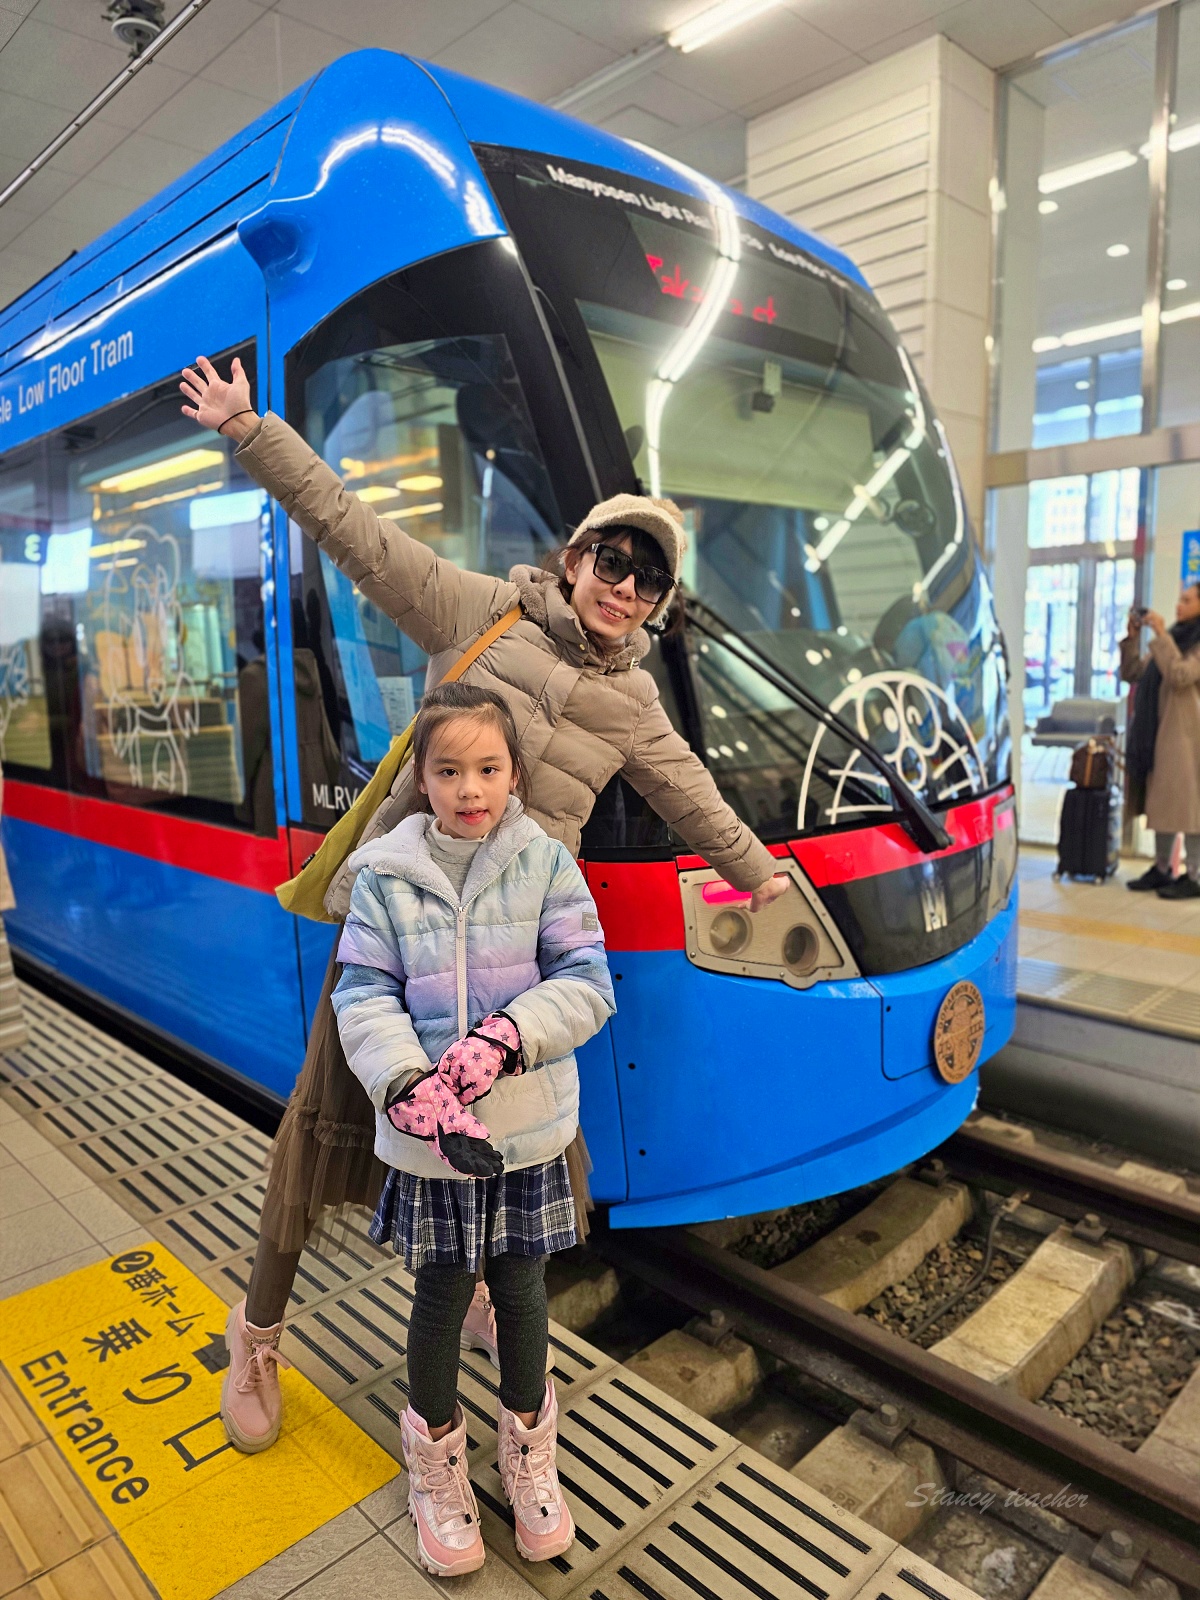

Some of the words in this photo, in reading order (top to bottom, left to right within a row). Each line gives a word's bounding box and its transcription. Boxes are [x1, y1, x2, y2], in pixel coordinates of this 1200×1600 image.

[640, 193, 684, 220] Light
[19, 380, 45, 414] Low
[49, 356, 87, 399] Floor
[90, 330, 133, 375] Tram
[20, 1350, 150, 1504] Entrance
